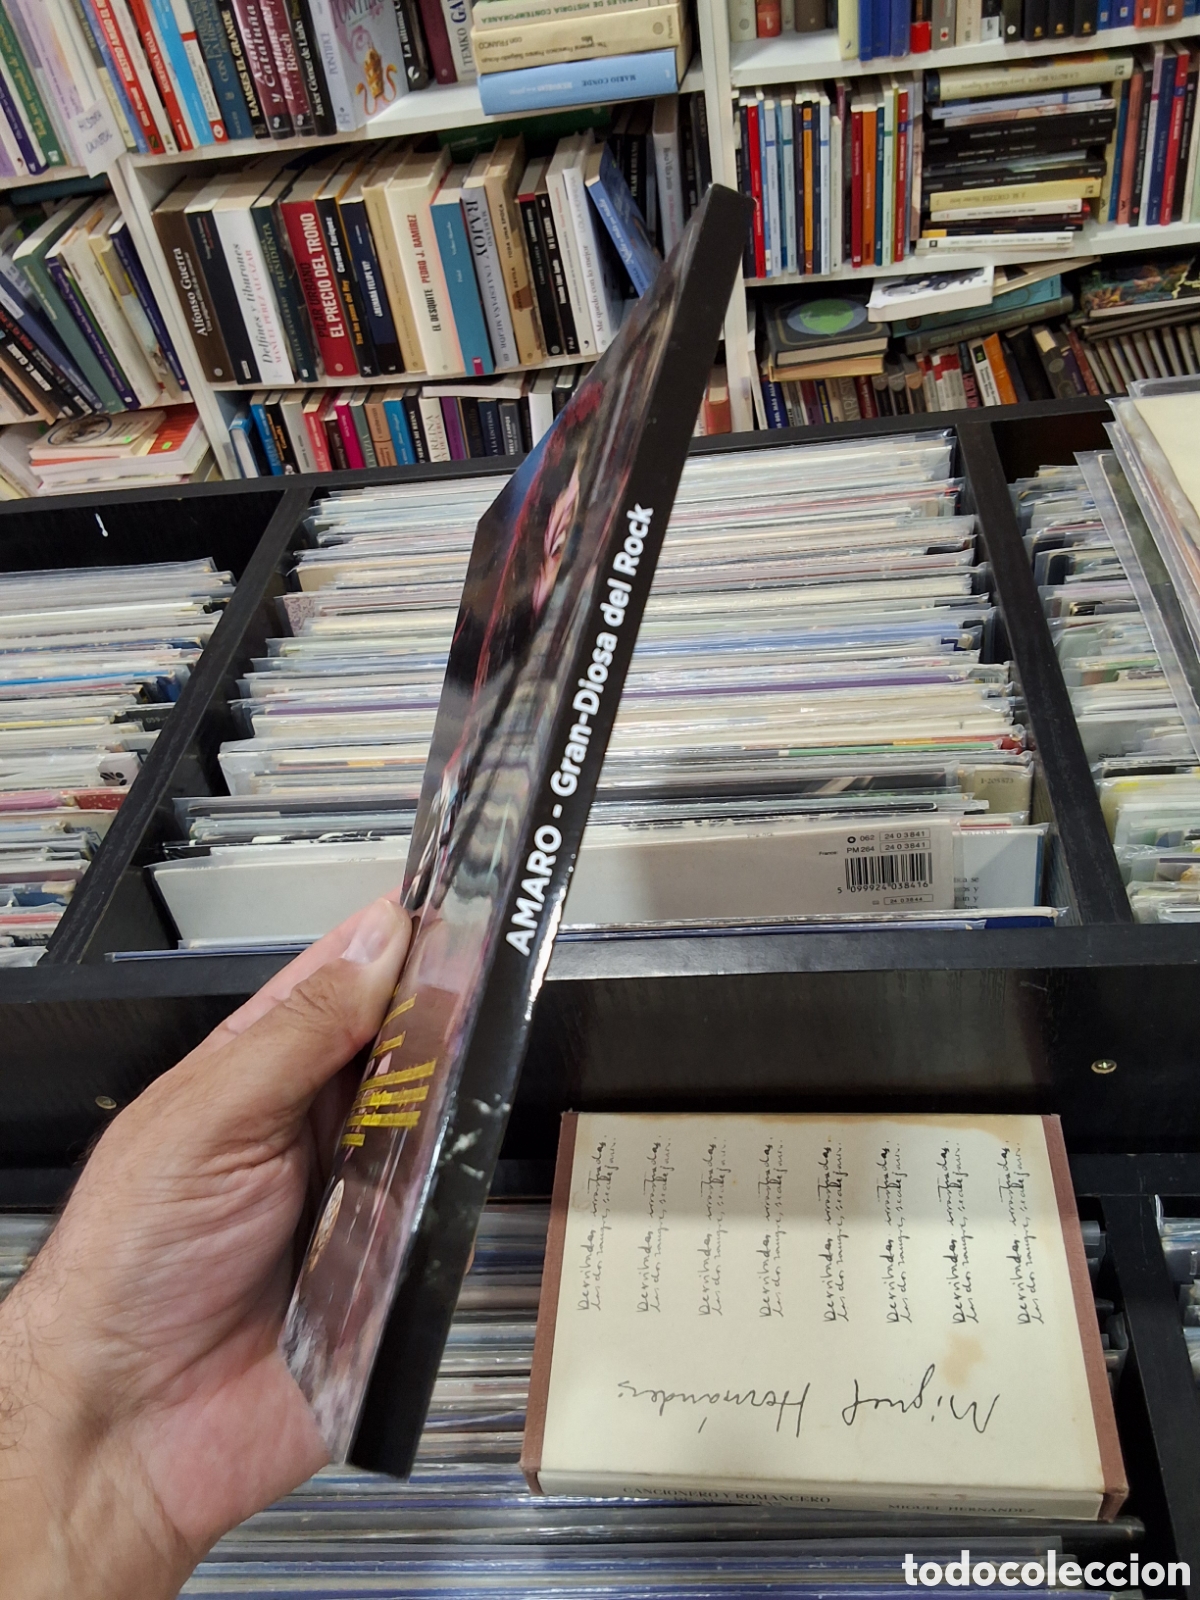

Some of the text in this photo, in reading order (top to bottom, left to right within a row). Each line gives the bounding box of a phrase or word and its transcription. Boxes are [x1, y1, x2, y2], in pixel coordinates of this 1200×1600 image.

[553, 0, 590, 12] HISTORIA
[102, 17, 122, 48] AMIGO
[392, 10, 412, 58] La última
[456, 26, 473, 66] TEMKO
[477, 36, 522, 50] con FRANCO
[113, 45, 135, 83] NUESTRO
[143, 30, 172, 94] MORFINA ROJA
[220, 8, 260, 117] RAMSES EL GRANDE
[240, 26, 266, 86] Azaña
[243, 3, 283, 104] y Cataluña
[260, 4, 295, 101] Los Milans del
[277, 32, 299, 73] Bosch
[293, 19, 324, 117] Javier Gómez de Liaño
[580, 73, 636, 87] MARIO CONDE
[626, 173, 639, 196] PILAR
[597, 196, 612, 218] nadie
[323, 215, 345, 273] Carmen Enríquez
[480, 209, 493, 247] MARIANO
[171, 245, 195, 290] Guerra
[260, 221, 287, 289] PRESIDENTA
[579, 243, 593, 268] mejor
[617, 240, 635, 264] Nadie
[230, 241, 256, 304] tiburones
[300, 210, 346, 338] EL PRECIO DEL TRONO
[363, 269, 377, 290] FELIPE
[405, 212, 442, 332] EL DESQUITE PEDRO J. RAMÍREZ
[464, 199, 507, 349] RAJOY UNA ESPAÑA MEJOR
[584, 268, 593, 278] lo
[588, 279, 597, 294] con
[186, 289, 210, 338] Alfonso
[300, 260, 331, 339] PILAR URBANO
[590, 294, 604, 319] quedo
[252, 314, 275, 365] Delfines
[594, 318, 604, 332] Me
[406, 410, 420, 439] MI REINA
[422, 414, 441, 451] REINA
[484, 410, 497, 439] LINTERNA
[490, 440, 497, 448] LA
[506, 502, 654, 956] AMARO - Gran-Diosa del Rock
[850, 884, 887, 892] 099924
[891, 881, 928, 890] 038416
[613, 1359, 1003, 1439] Miguel Hernández
[622, 1487, 717, 1503] CANCIONERO
[721, 1494, 729, 1502] Y
[734, 1492, 831, 1509] ROMANCERO
